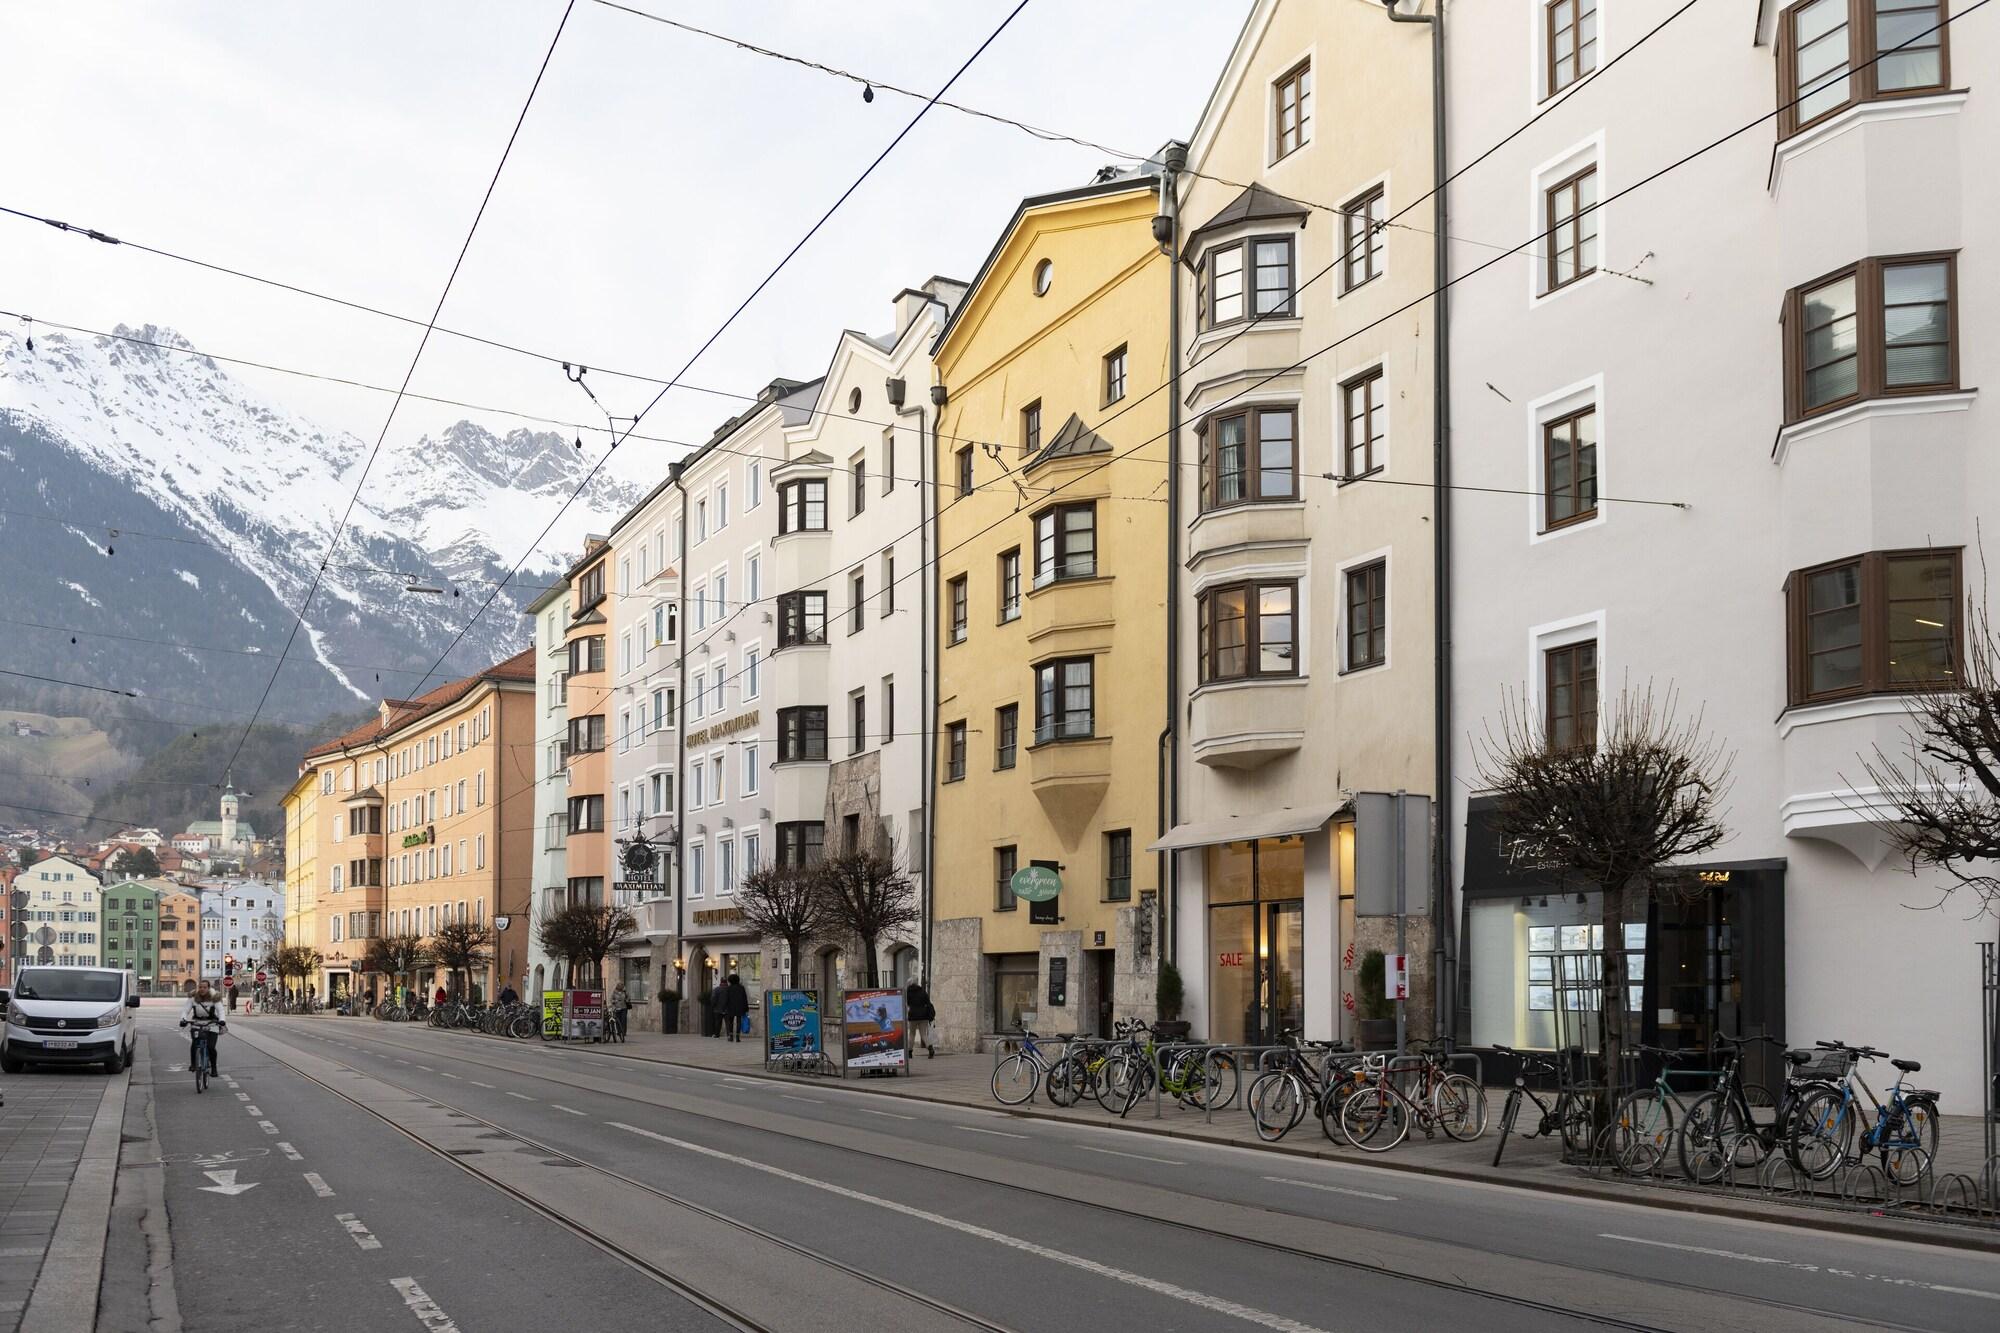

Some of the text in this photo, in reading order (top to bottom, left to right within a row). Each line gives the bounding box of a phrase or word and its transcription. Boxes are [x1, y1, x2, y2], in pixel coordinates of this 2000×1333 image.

[687, 710, 759, 748] HOTEL MAXIMILIAN
[1019, 878, 1057, 890] evergreen
[1220, 953, 1243, 967] SALE
